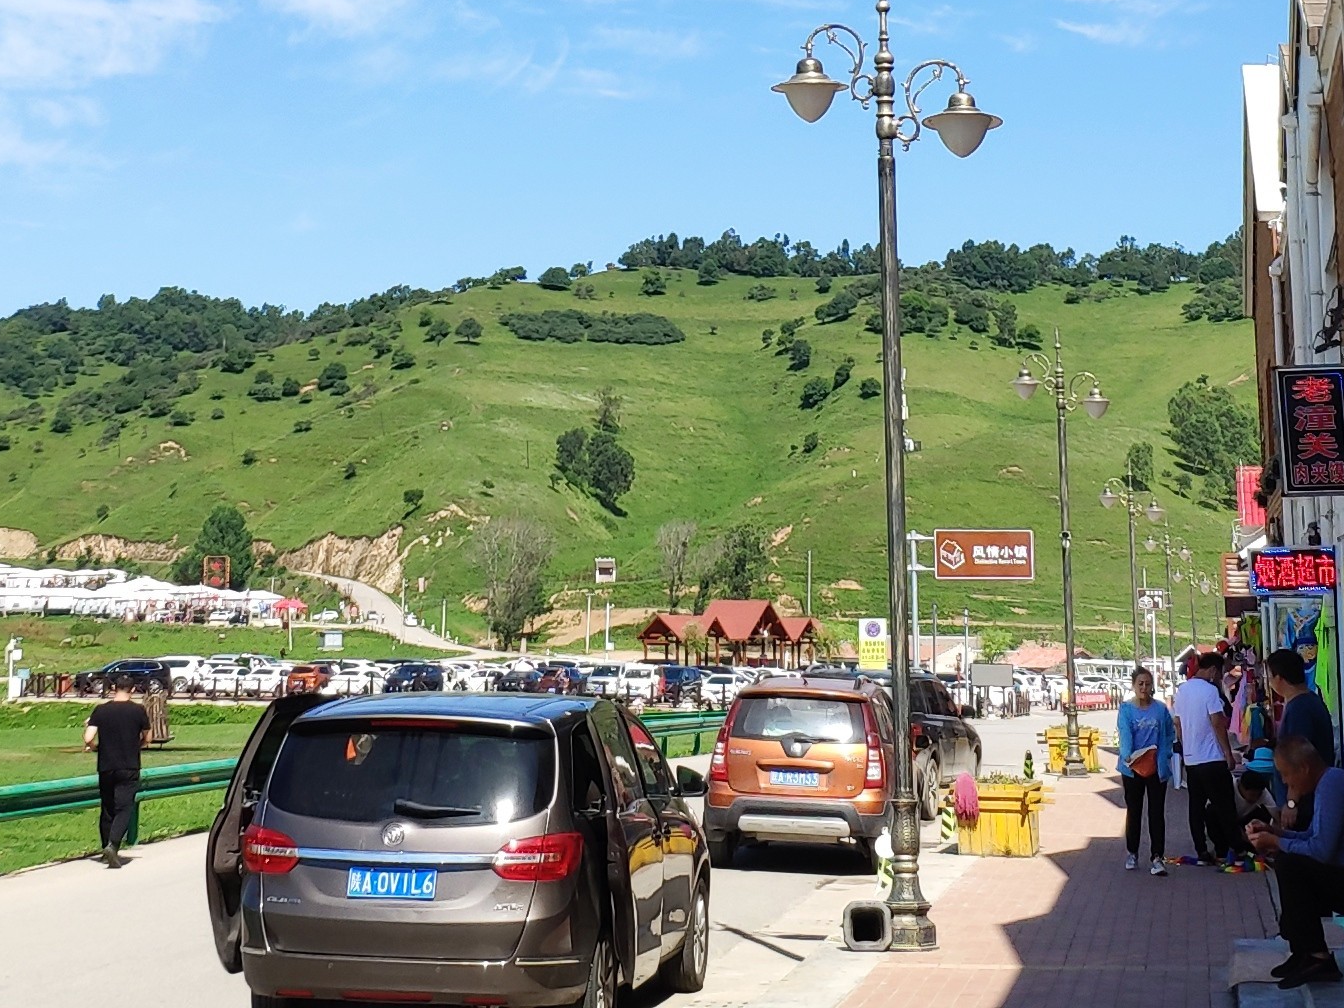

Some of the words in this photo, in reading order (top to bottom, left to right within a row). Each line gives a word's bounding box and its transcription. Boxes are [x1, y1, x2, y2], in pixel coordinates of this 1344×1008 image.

[1291, 376, 1339, 460] 老潼关
[972, 545, 1027, 558] 风情小镇
[1255, 553, 1335, 587] 烟酒超市
